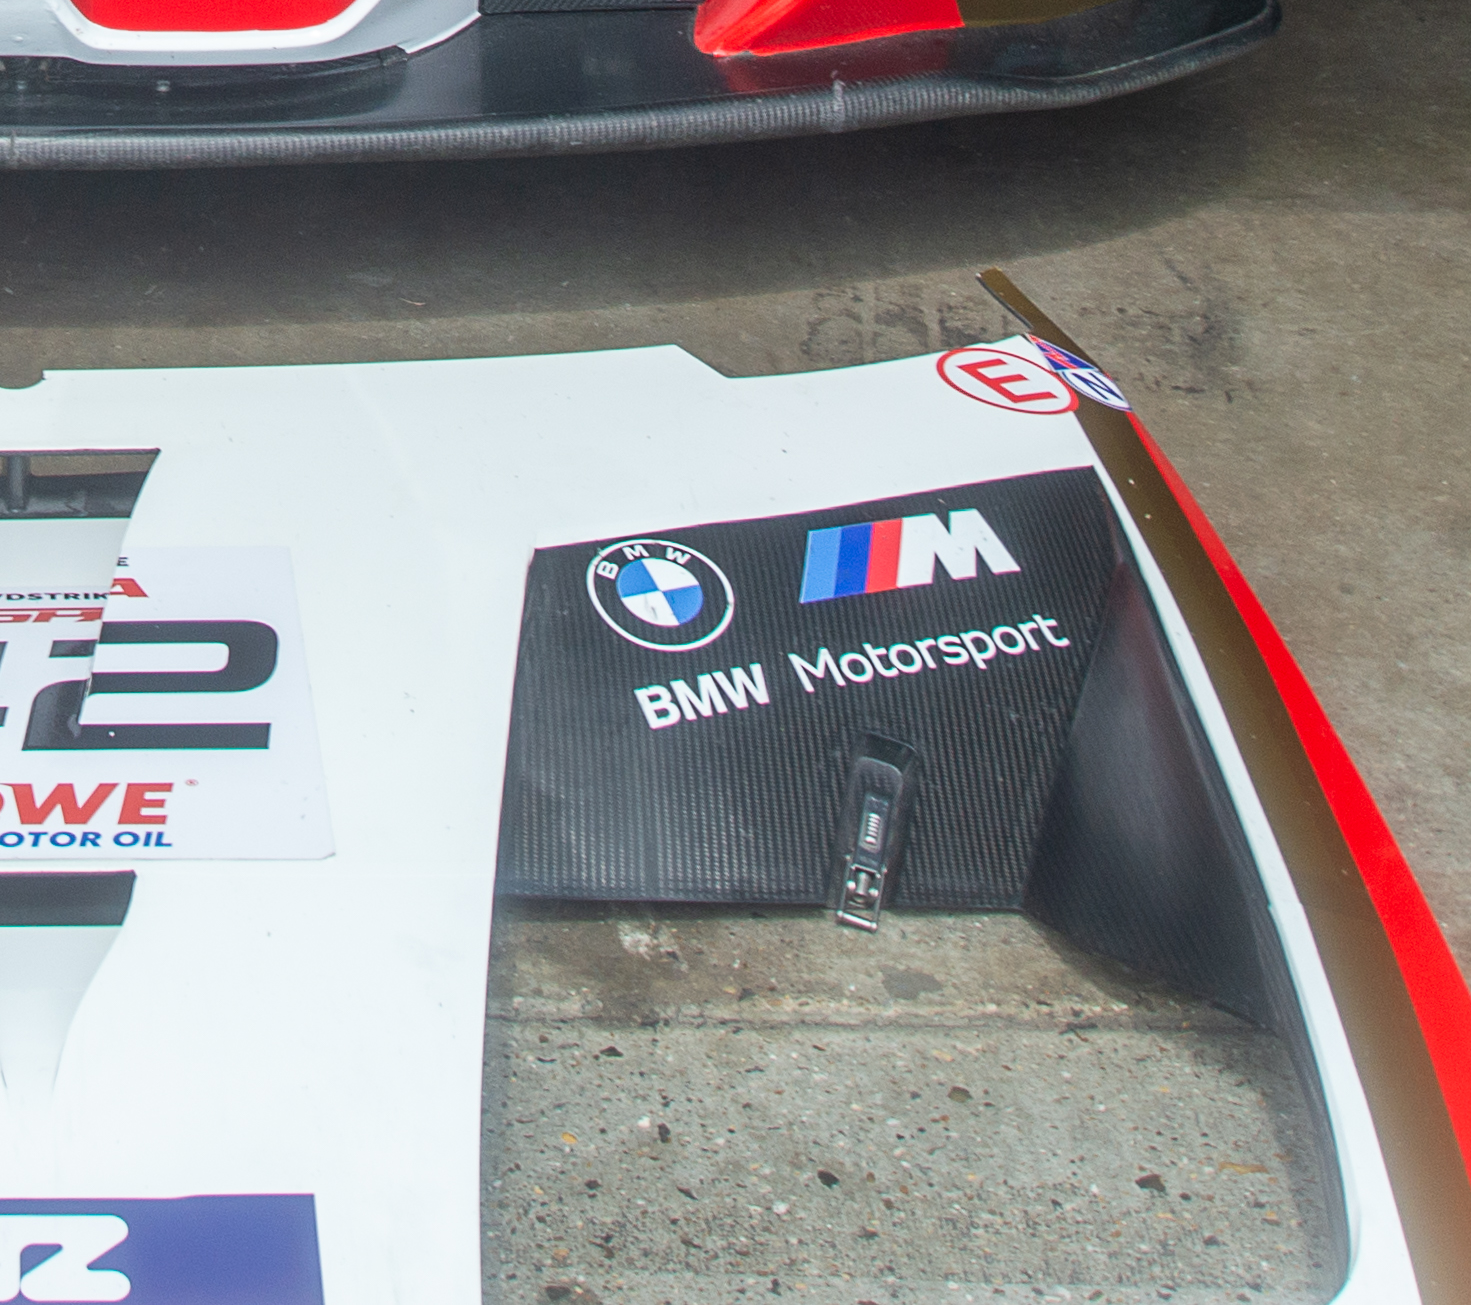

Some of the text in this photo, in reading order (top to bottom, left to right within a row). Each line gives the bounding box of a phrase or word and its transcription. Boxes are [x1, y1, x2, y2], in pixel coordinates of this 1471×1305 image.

[955, 358, 1060, 404] E
[595, 543, 693, 582] BMW
[633, 613, 1072, 730] BMW Motorsport
[112, 831, 174, 848] OIL
